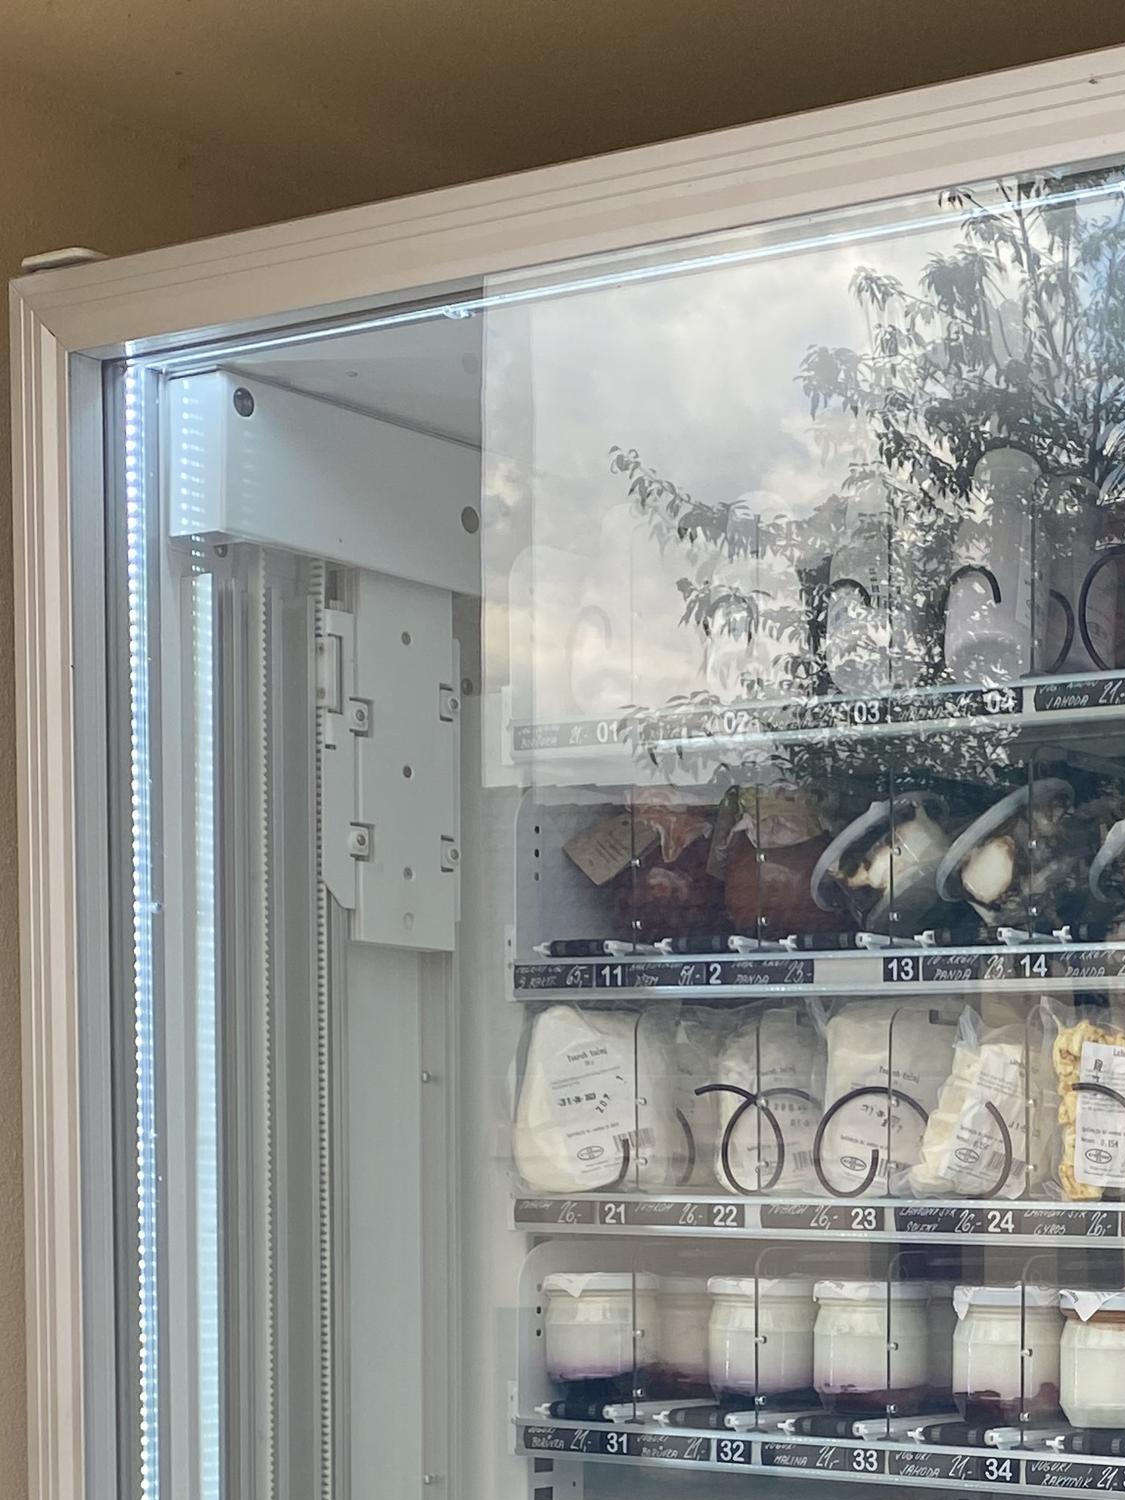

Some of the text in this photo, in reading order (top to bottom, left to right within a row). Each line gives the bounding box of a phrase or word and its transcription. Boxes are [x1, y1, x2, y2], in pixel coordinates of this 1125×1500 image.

[853, 700, 880, 724] 03
[1046, 694, 1089, 709] JAHODA
[596, 720, 618, 742] 01
[723, 710, 750, 735] 02
[601, 964, 623, 987] 11
[709, 962, 722, 985] 2
[887, 957, 914, 981] 13
[933, 967, 972, 981] PANDA
[1019, 953, 1048, 978] 14
[1064, 966, 1106, 978] PANDA
[604, 1203, 626, 1224] 21
[713, 1205, 738, 1226] 22
[851, 1208, 878, 1230] 23
[987, 1211, 1015, 1233] 24
[606, 1433, 629, 1454] 31
[720, 1440, 744, 1462] 32
[773, 1455, 808, 1466] MALINA
[852, 1449, 878, 1472] 33
[899, 1464, 940, 1478] JAHODA
[985, 1458, 1012, 1481] 34
